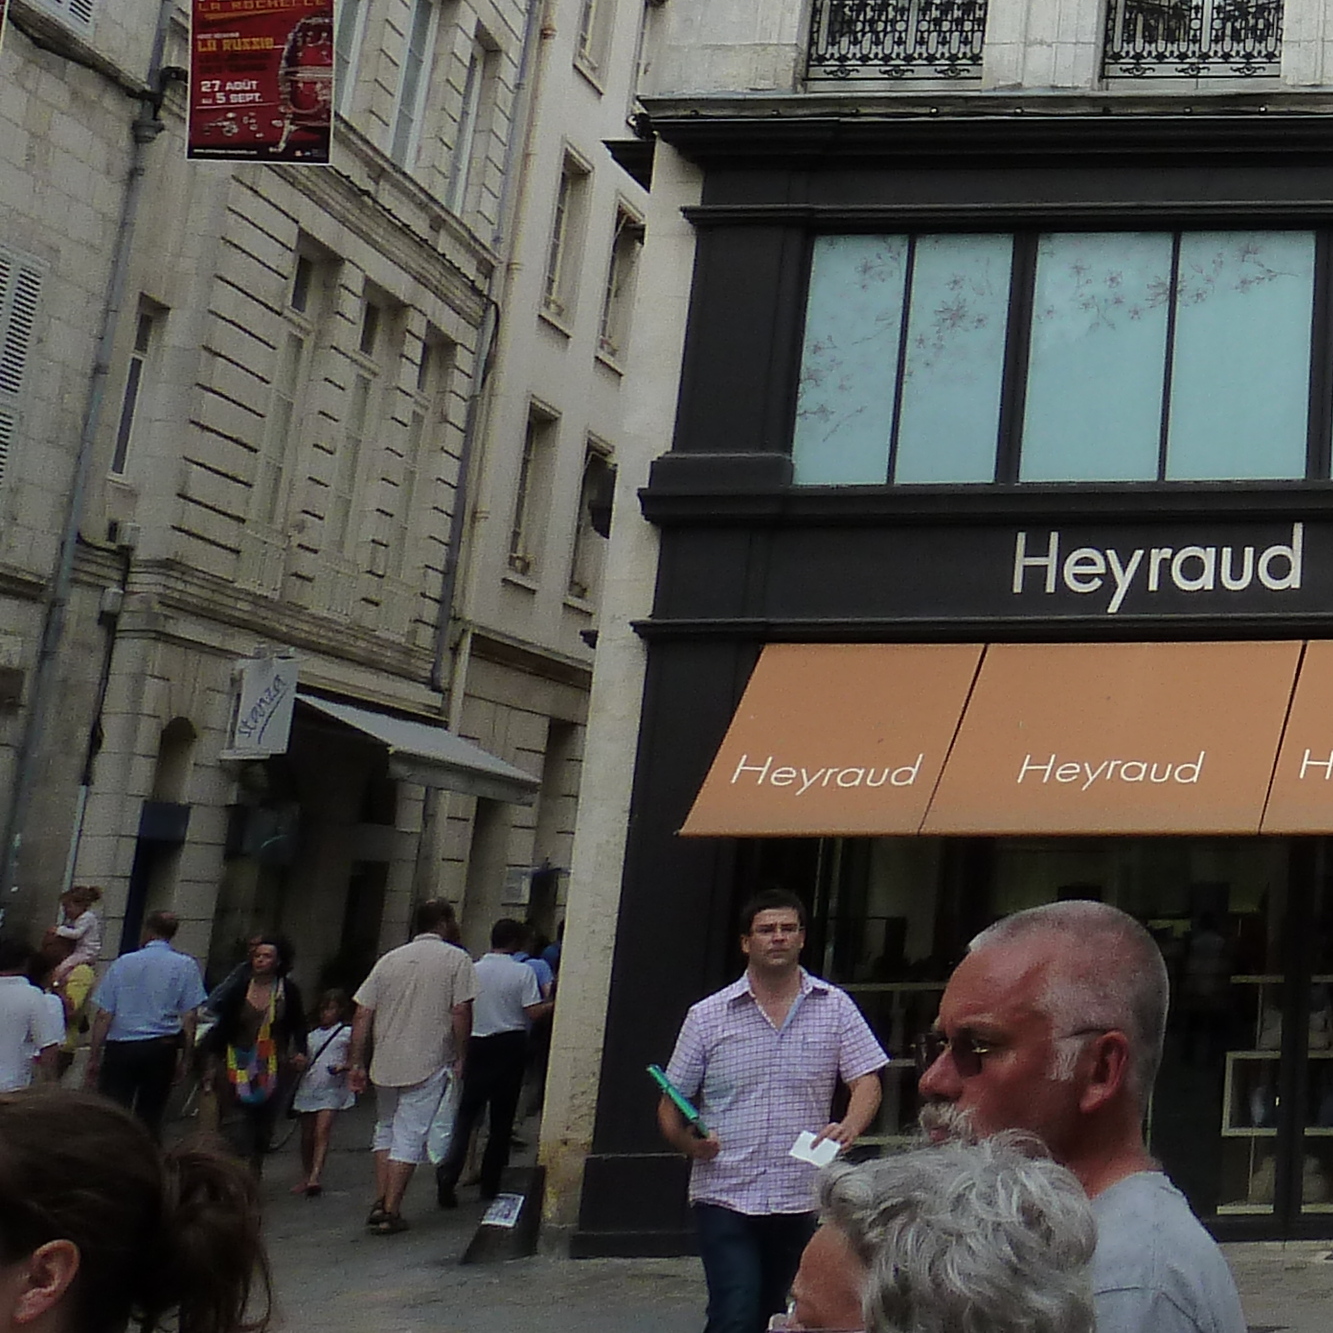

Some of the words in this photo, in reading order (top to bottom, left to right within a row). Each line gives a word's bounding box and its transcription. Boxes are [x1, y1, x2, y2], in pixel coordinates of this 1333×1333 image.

[199, 2, 221, 12] LA
[201, 80, 221, 92] 27
[226, 79, 259, 91] AOÛT
[216, 93, 226, 103] 5
[230, 93, 263, 103] SEPT.
[1012, 522, 1304, 614] Heyraud
[238, 674, 287, 738] stanza
[730, 753, 923, 795] Heyraud
[1017, 750, 1205, 792] Heyraud
